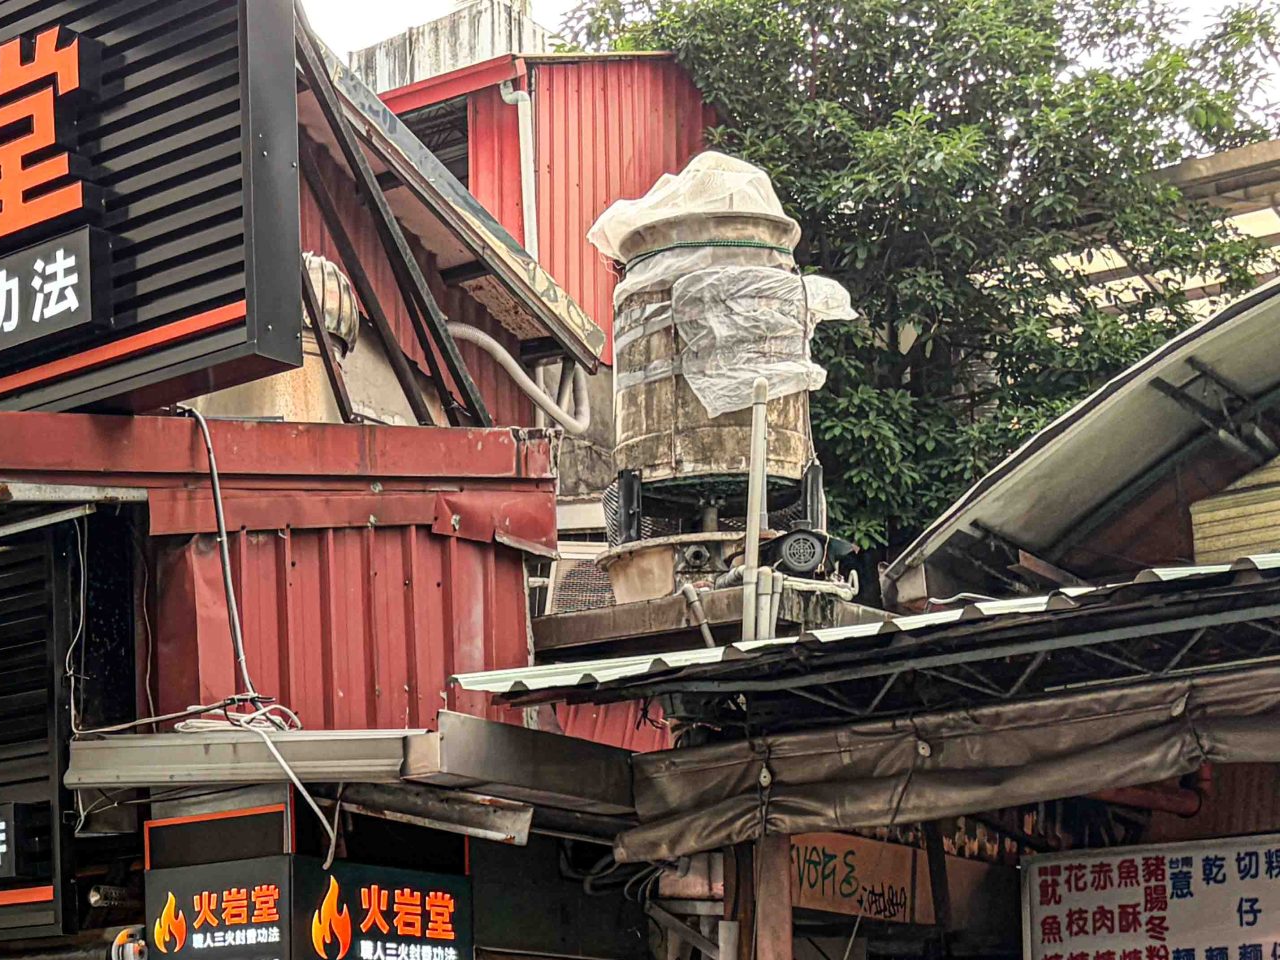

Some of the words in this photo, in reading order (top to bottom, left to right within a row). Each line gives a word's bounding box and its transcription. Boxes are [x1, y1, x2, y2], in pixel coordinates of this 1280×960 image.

[193, 884, 280, 929] 火岩堂
[360, 884, 455, 940] 火岩堂
